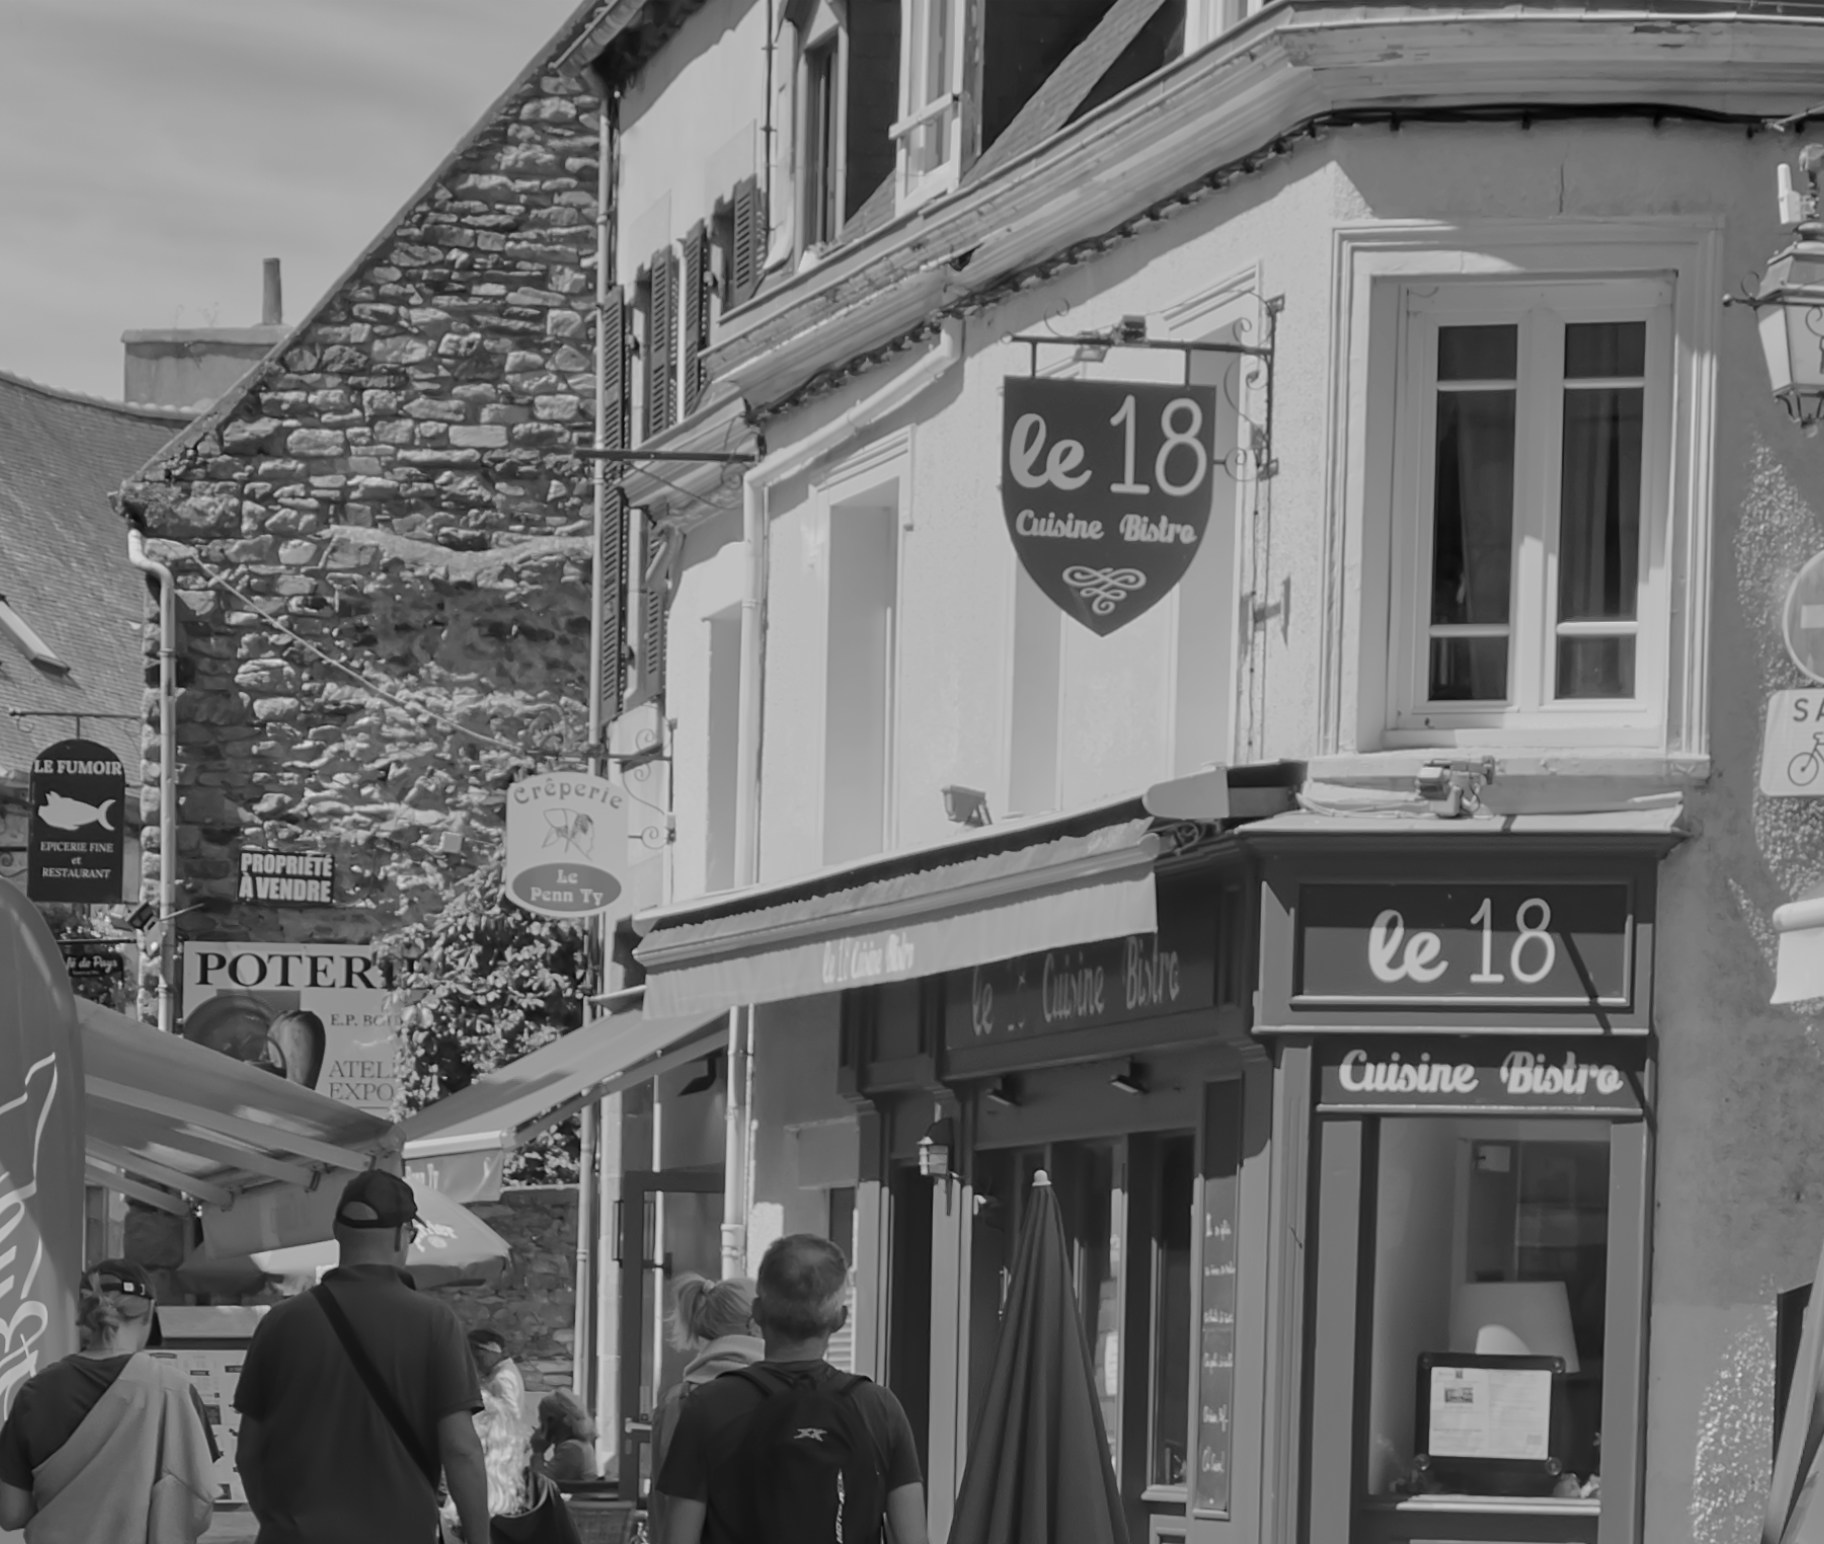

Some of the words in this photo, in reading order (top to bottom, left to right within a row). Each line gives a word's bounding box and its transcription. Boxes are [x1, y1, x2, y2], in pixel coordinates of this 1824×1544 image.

[1009, 412, 1093, 492] le
[1109, 394, 1208, 497] 18
[1015, 508, 1105, 540] Cuisine
[1119, 513, 1198, 545] Bistro
[33, 759, 54, 775] LE
[57, 759, 123, 776] FUMOIR
[513, 777, 624, 810] Crêperie
[40, 841, 88, 853] EPICERIE
[89, 843, 115, 853] FINE
[41, 866, 112, 879] RESTAURANT
[241, 852, 333, 877] PROPRIÉTÉ
[556, 869, 579, 884] Le
[238, 872, 254, 899] À
[255, 876, 332, 902] VENDRE
[529, 887, 574, 903] Penn
[579, 888, 604, 907] Ty
[1367, 908, 1449, 983] le
[1469, 897, 1556, 984] 18
[1042, 951, 1106, 1023] Cuisine
[1122, 934, 1180, 1010] Bistro
[1338, 1049, 1480, 1093] Cuisine
[1499, 1050, 1625, 1095] Bistro
